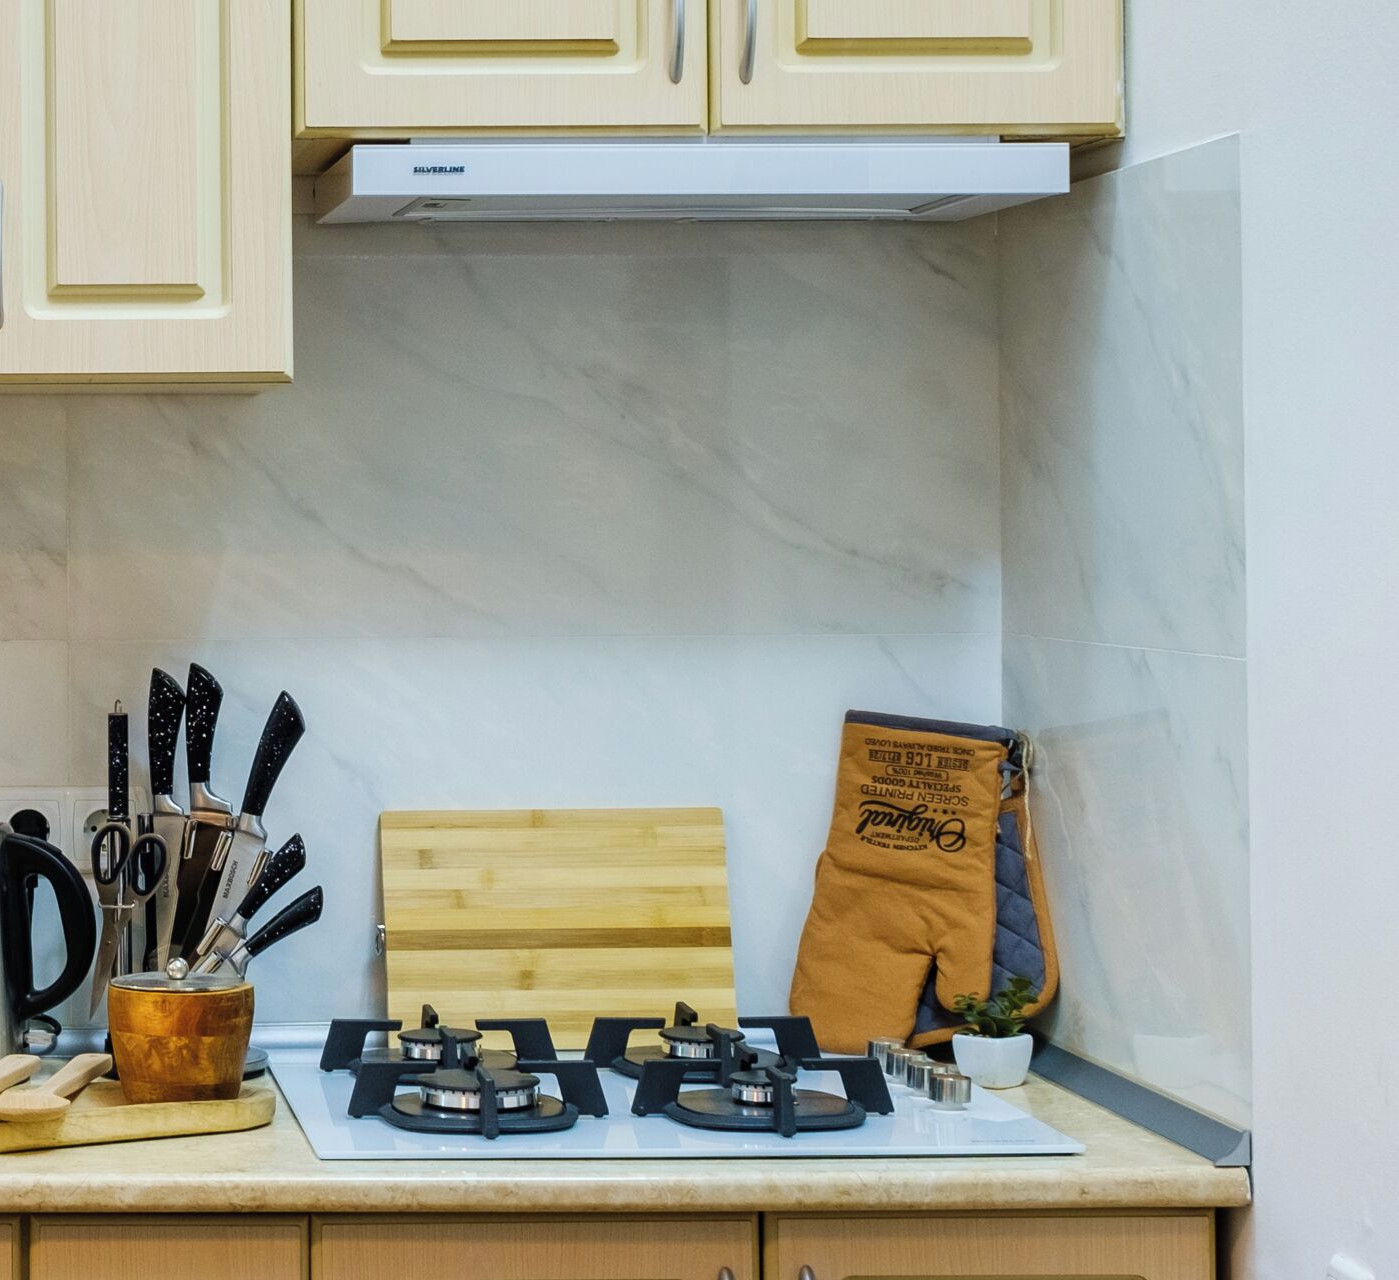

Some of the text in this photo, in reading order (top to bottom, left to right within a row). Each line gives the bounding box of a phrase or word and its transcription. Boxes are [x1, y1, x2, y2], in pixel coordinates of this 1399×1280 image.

[865, 738, 891, 747] LOVED
[892, 740, 925, 750] ALWAYS
[872, 775, 961, 793] SPECIALTY GOODS
[861, 784, 969, 807] SCREEN PRINTED
[855, 800, 967, 853] Original
[893, 842, 928, 851] KITCHEN
